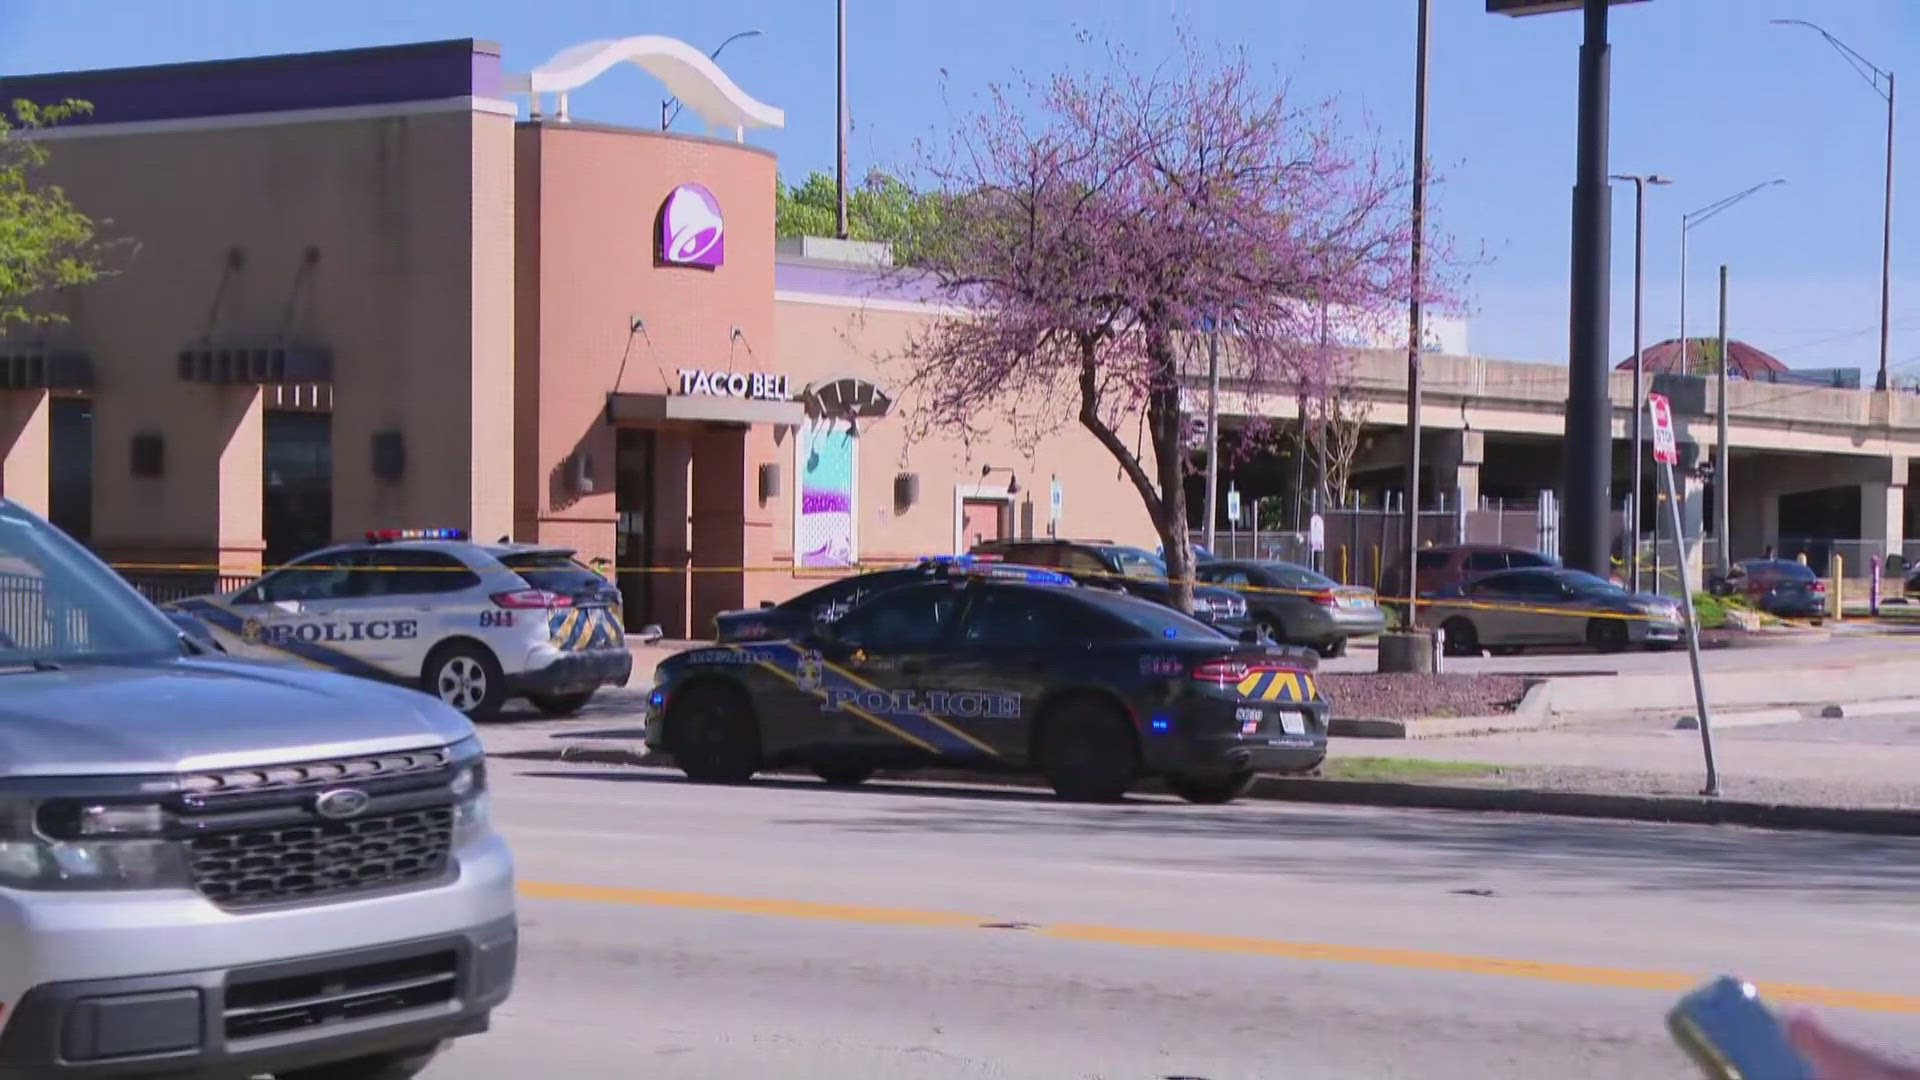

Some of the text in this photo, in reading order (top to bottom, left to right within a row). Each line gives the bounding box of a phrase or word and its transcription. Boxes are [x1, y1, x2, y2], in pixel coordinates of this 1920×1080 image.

[680, 369, 793, 400] TACO BELL
[267, 619, 418, 644] POLICE
[820, 688, 1022, 719] POLICE
